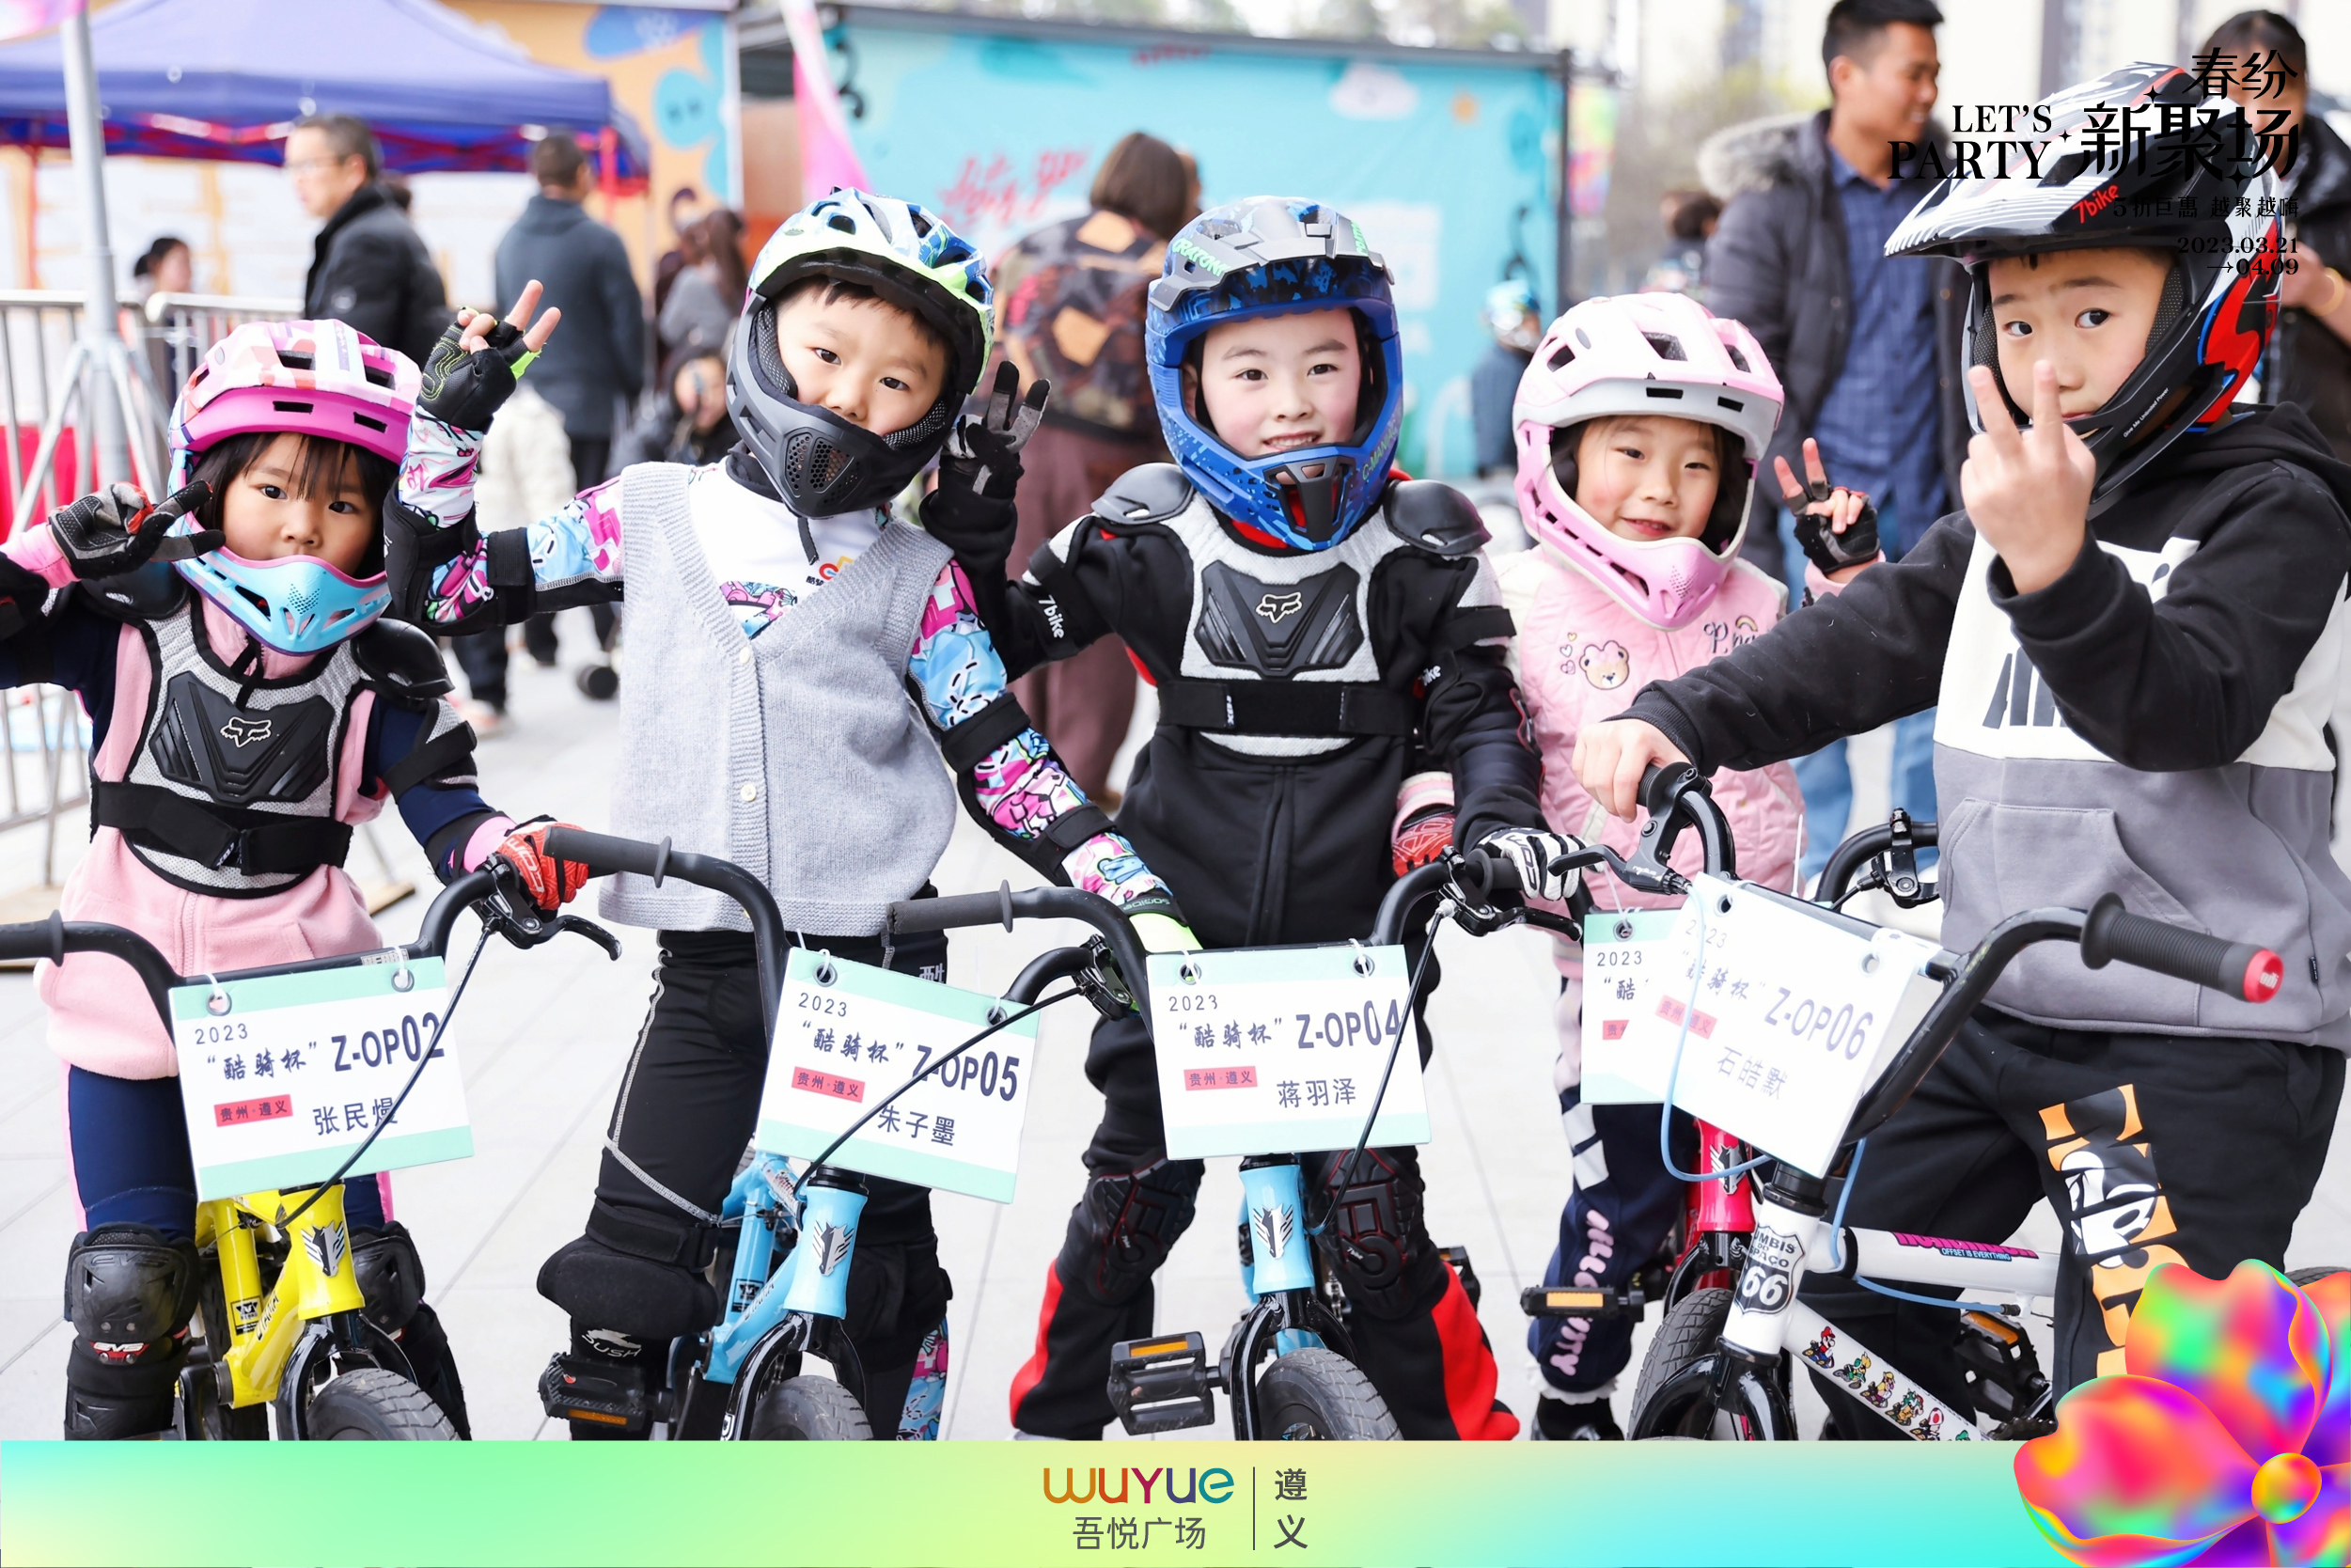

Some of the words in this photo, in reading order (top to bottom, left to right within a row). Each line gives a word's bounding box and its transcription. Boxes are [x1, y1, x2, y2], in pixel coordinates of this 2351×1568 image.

[2072, 185, 2120, 224] 7bike
[1038, 594, 1064, 638] 7bike
[1685, 919, 1728, 949] 223
[1597, 950, 1642, 966] 2023
[798, 992, 847, 1017] 2023
[1168, 995, 1218, 1011] 2023
[195, 1023, 248, 1044] 2023
[331, 1012, 445, 1072] Z-OP02
[803, 1020, 903, 1064] “酷骑杯”
[1179, 1018, 1281, 1049] “酷骑杯”
[1296, 999, 1403, 1049] Z-OP04
[1764, 987, 1873, 1060] Z-OP06
[207, 1041, 317, 1080] “酷骑杯”
[913, 1044, 1020, 1102] Z-OP05
[1277, 1078, 1356, 1108] 蒋羽泽
[878, 1105, 955, 1147] 朱子墨
[1941, 1247, 1965, 1258] OFFSET
[1973, 1250, 2011, 1261] EVERYTHING
[1741, 1265, 1788, 1306] 66
